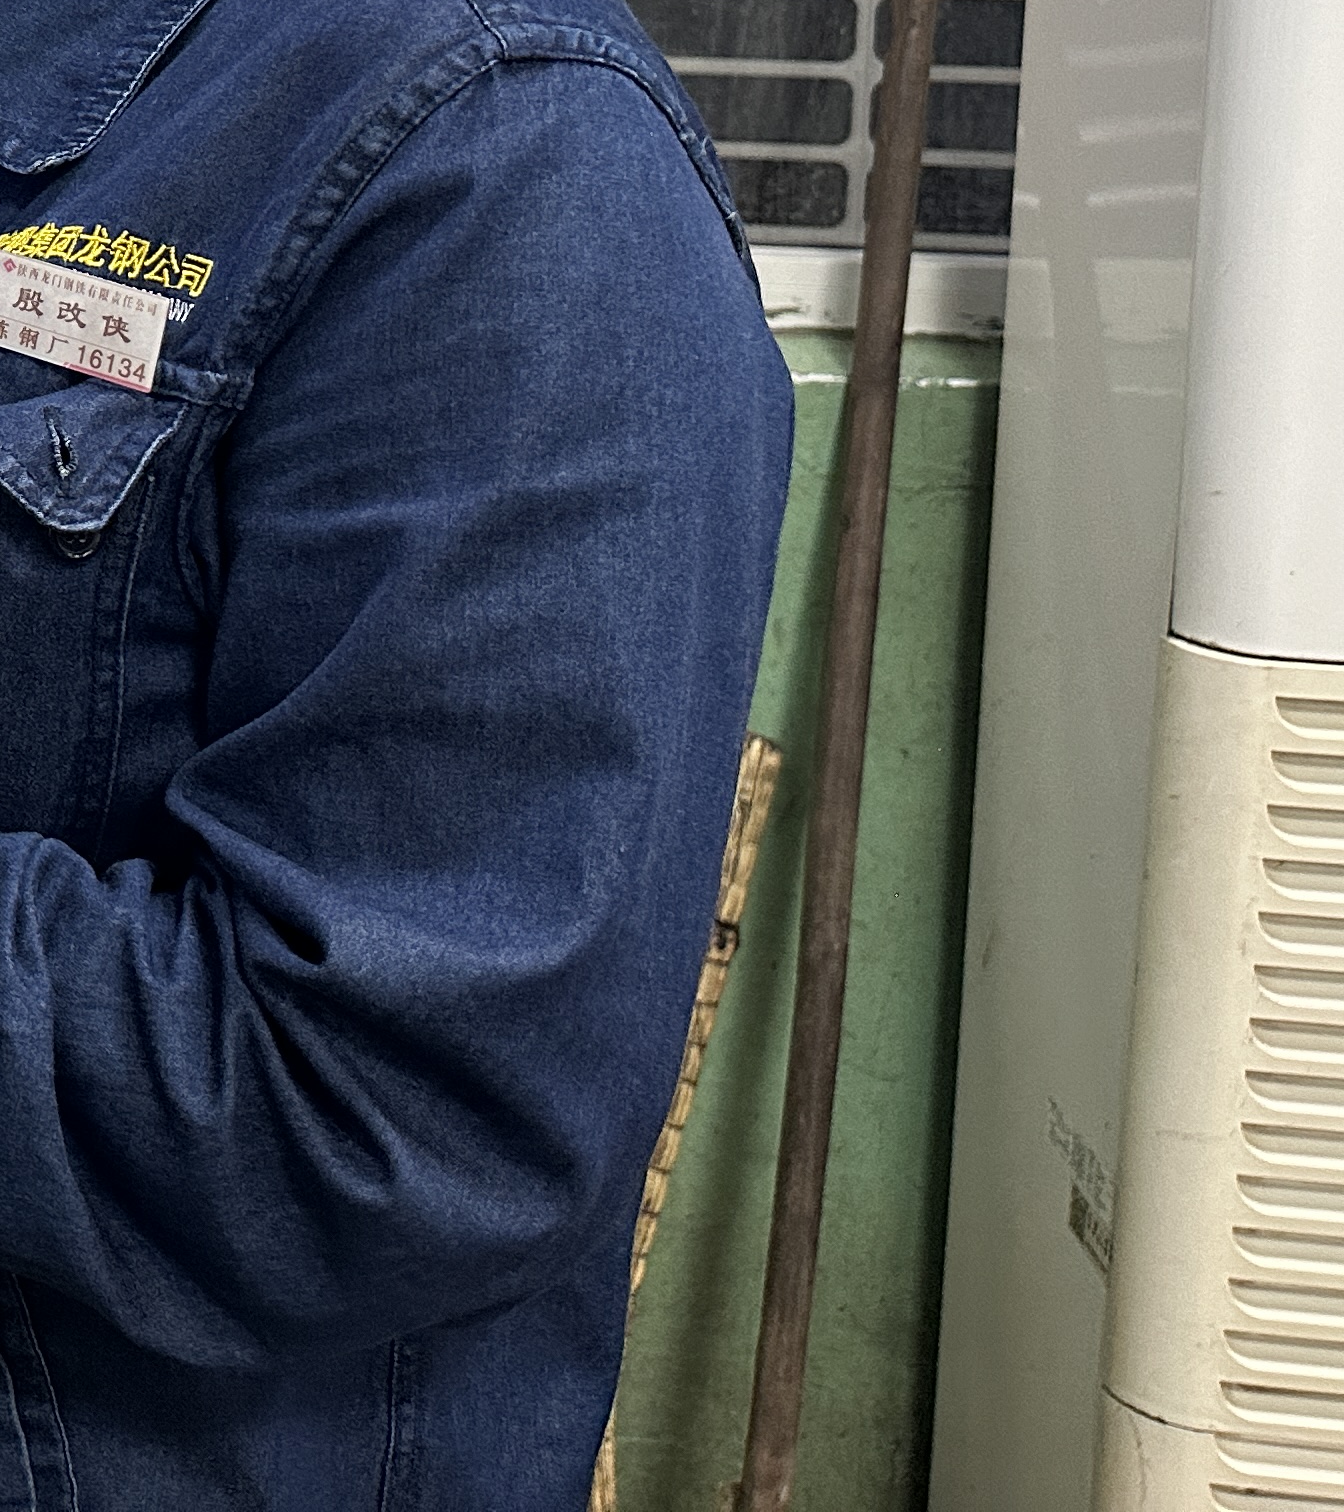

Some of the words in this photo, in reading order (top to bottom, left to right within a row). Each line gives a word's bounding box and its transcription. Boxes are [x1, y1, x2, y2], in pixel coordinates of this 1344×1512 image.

[12, 288, 131, 344] 殷改侠
[16, 263, 158, 317] 陕西龙门钢铁有限责任公司
[78, 344, 146, 383] 16134
